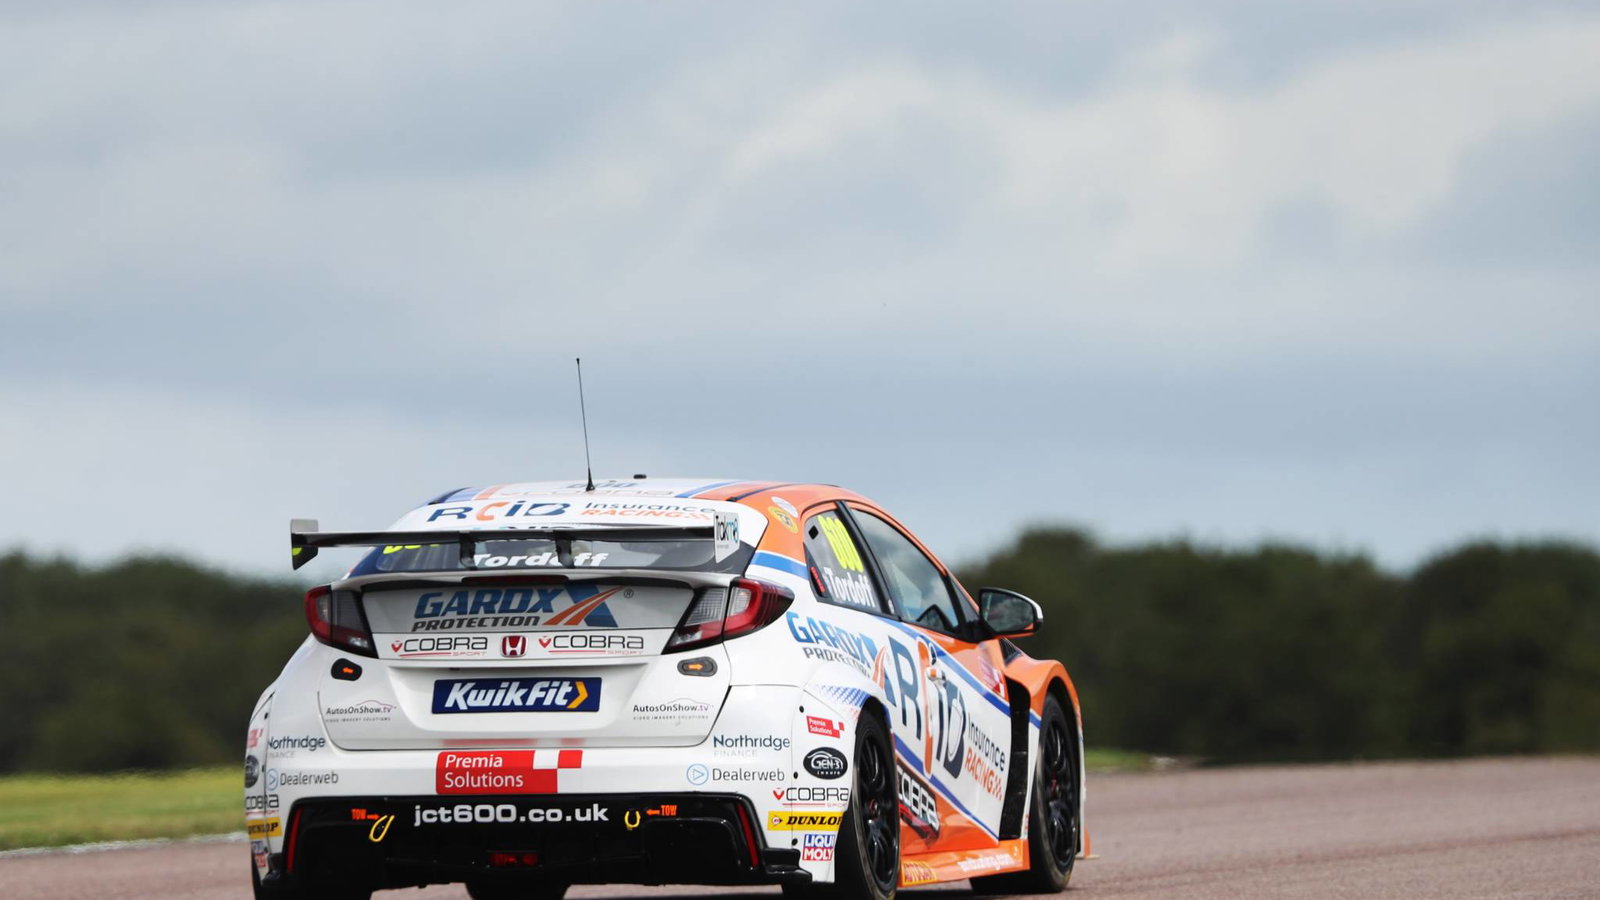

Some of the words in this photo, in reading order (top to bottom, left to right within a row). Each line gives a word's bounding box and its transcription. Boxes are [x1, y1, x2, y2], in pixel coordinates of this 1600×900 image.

[581, 509, 680, 519] RACING
[586, 502, 716, 513] Insurance
[823, 566, 876, 608] Tordoff
[632, 702, 709, 713] AutosOnShow.tv
[713, 734, 791, 751] Northridge
[967, 711, 1006, 772] Insurance
[445, 754, 504, 769] Premia
[712, 768, 785, 781] Dealerweb
[965, 746, 995, 794] RACING
[280, 771, 339, 786] Dealerweb
[444, 771, 525, 789] Solutions
[413, 803, 610, 828] jct600.co.uk
[660, 804, 678, 817] TOW
[802, 847, 833, 861] MOLY
